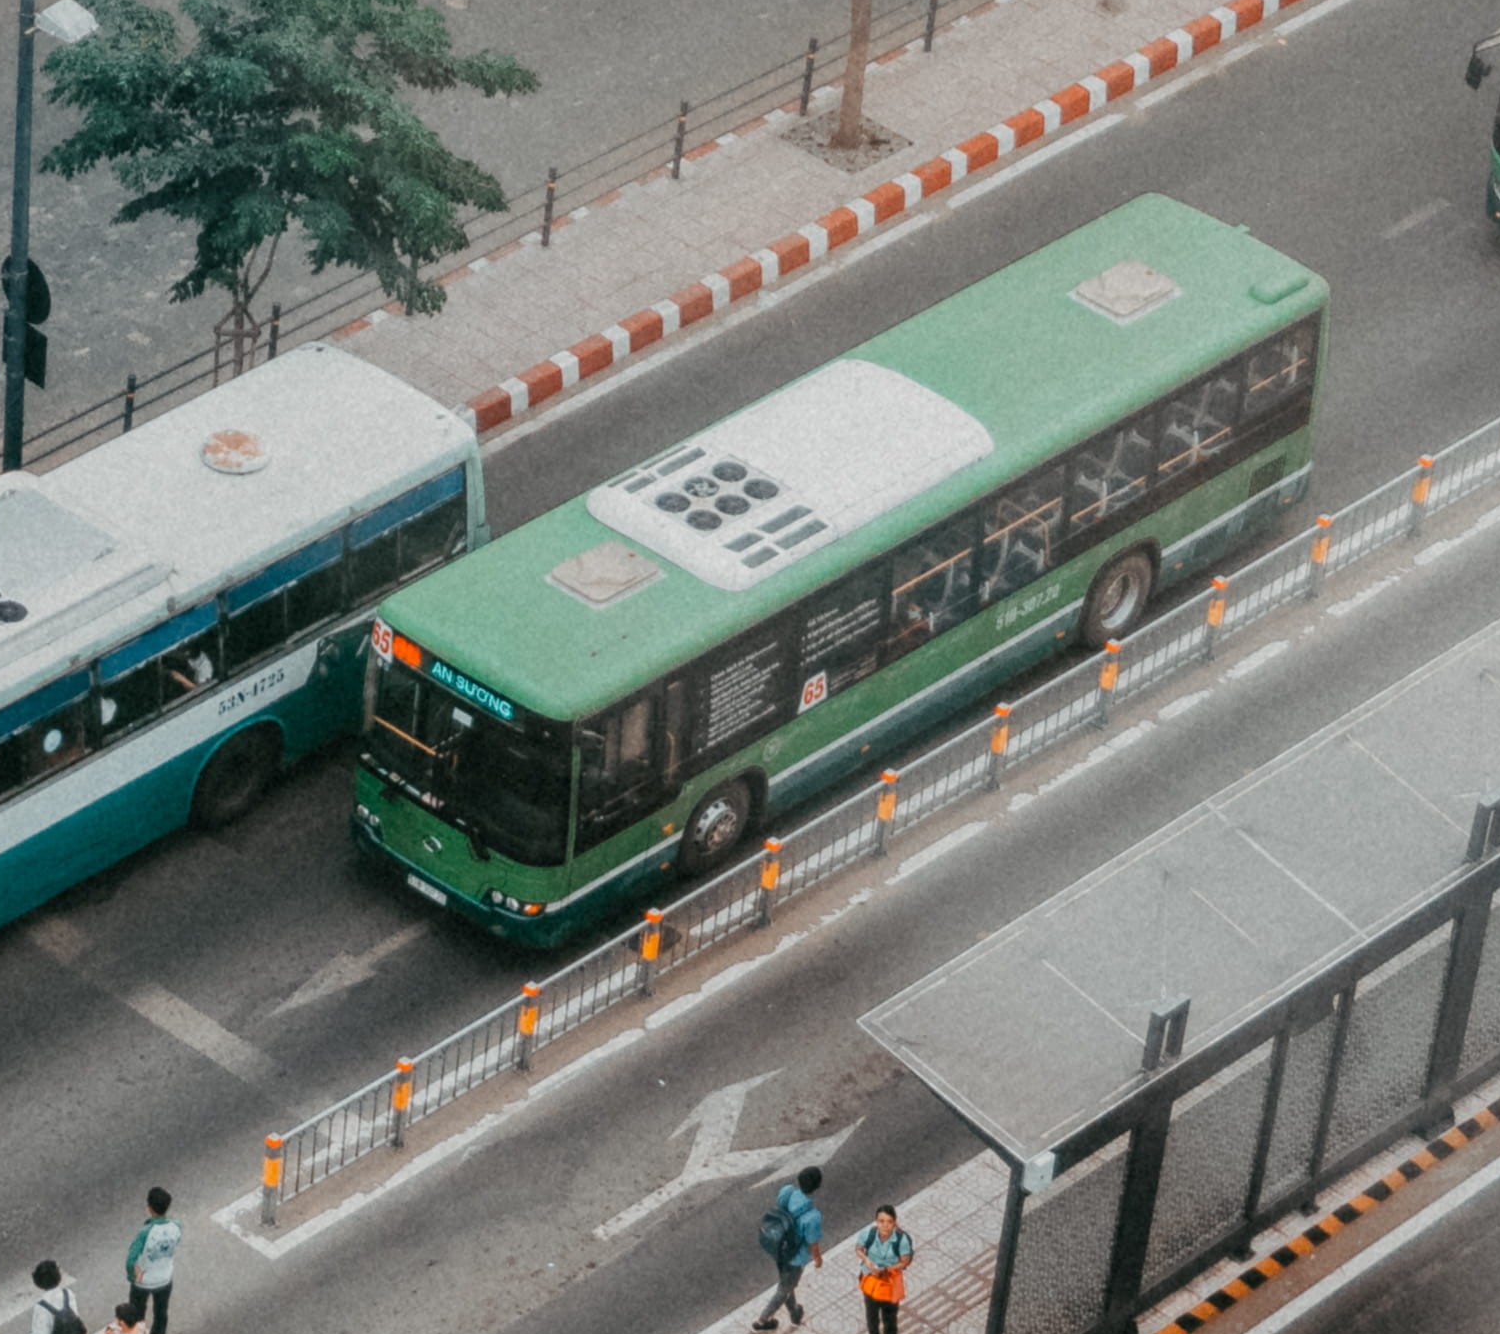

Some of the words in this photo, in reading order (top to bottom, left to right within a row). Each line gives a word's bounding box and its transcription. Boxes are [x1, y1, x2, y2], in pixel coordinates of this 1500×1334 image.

[372, 622, 390, 653] 65
[432, 662, 452, 682] AN
[455, 675, 513, 717] SƯƠNG
